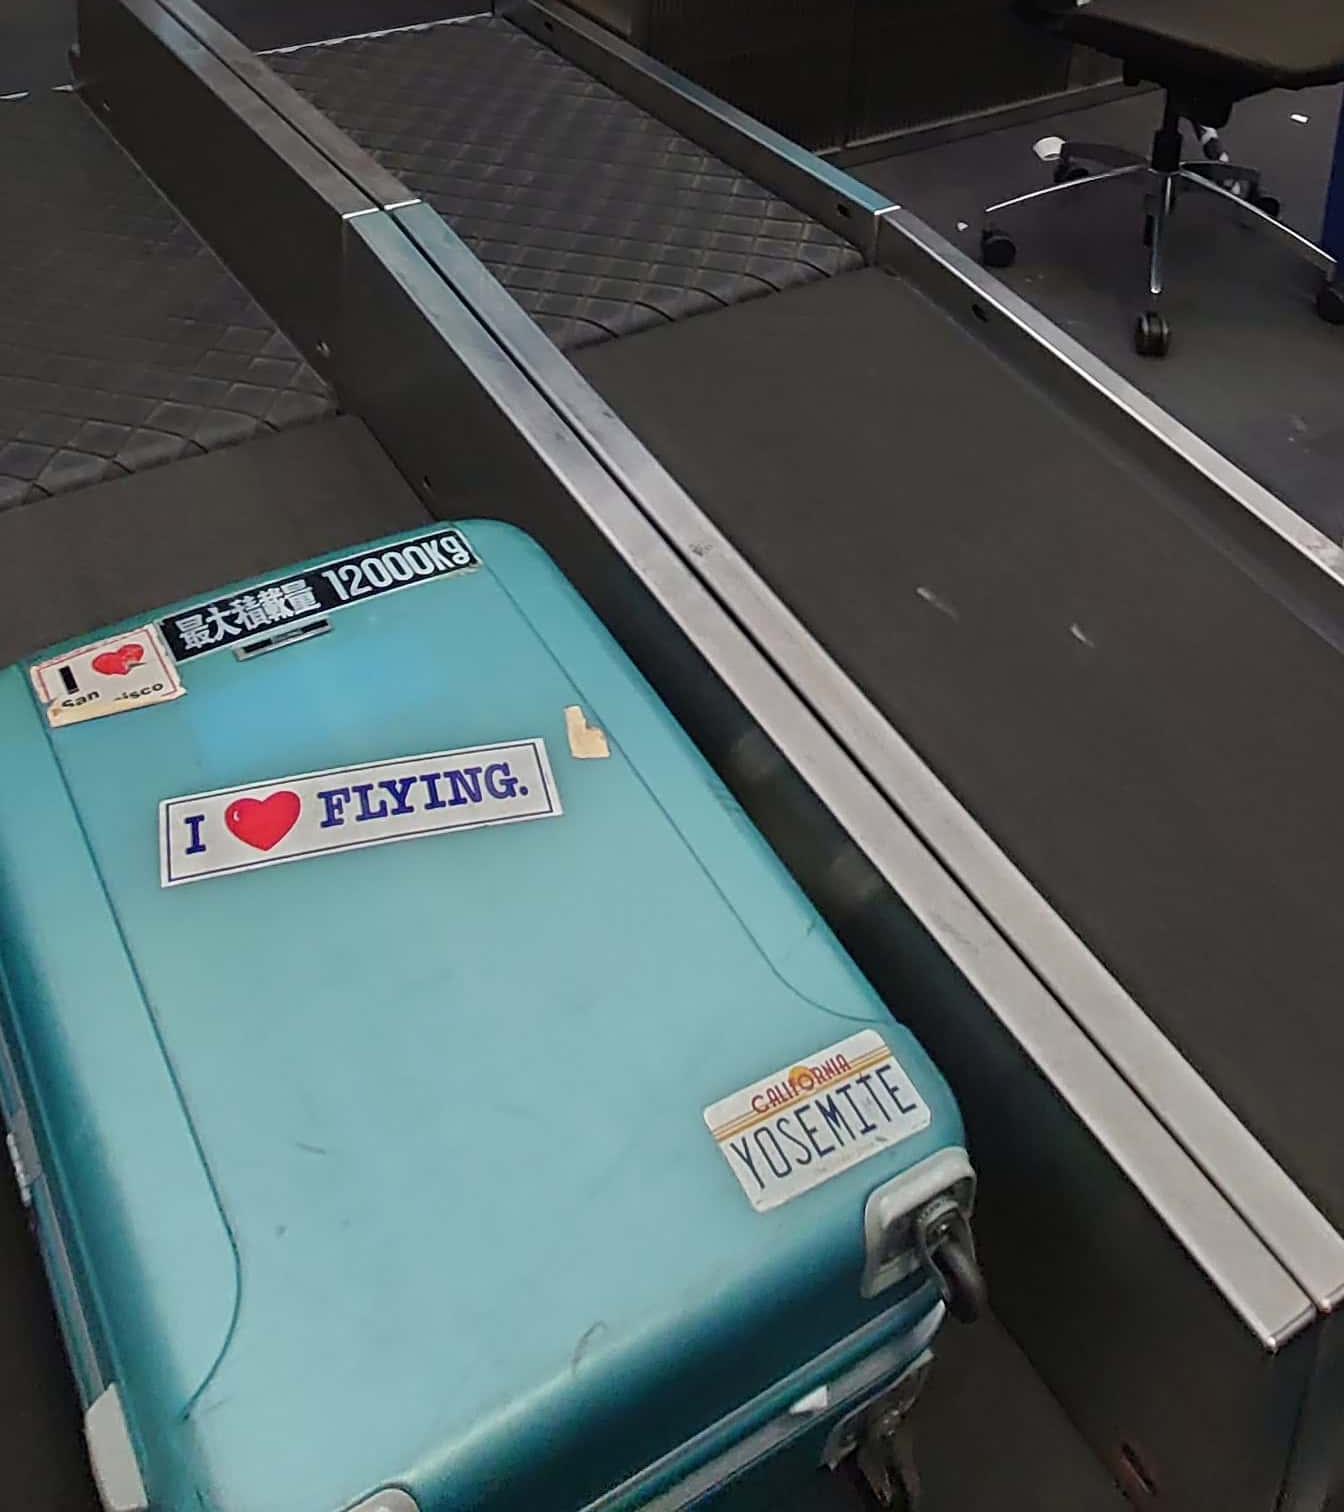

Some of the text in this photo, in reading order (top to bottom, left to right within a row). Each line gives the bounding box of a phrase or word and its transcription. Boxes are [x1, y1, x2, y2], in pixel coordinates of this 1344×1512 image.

[175, 578, 322, 651] 最大積載量
[59, 664, 80, 695] I
[184, 761, 529, 855] I FLYING.
[751, 1053, 852, 1115] CALIFORNIA
[729, 1063, 918, 1189] YOSEMITE
